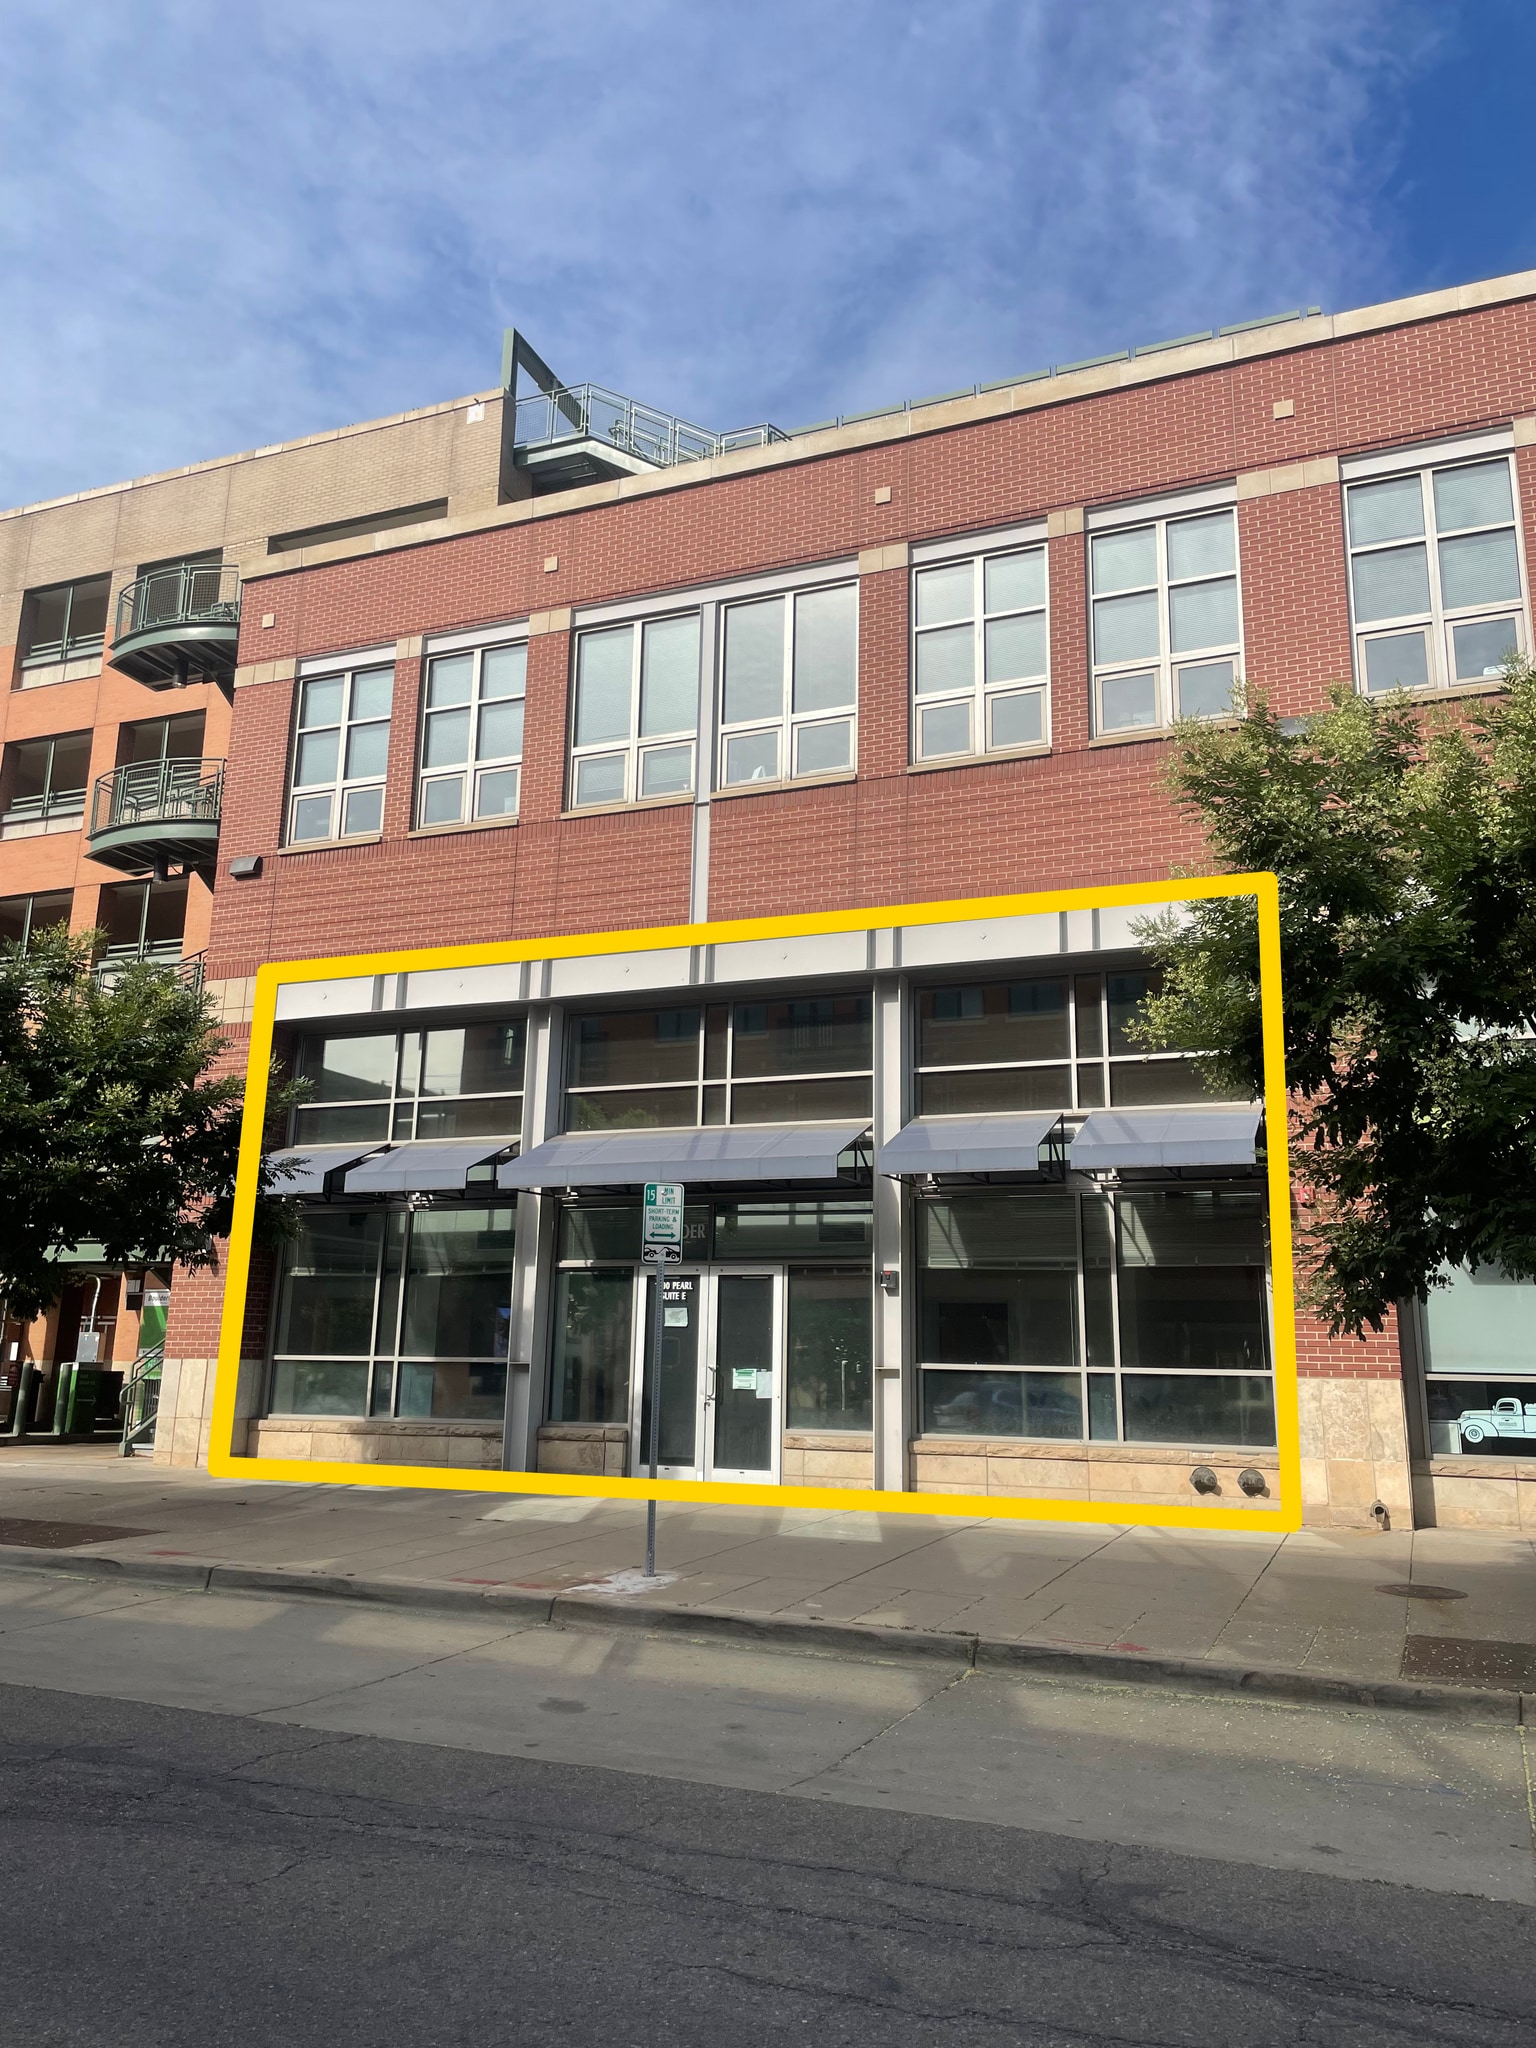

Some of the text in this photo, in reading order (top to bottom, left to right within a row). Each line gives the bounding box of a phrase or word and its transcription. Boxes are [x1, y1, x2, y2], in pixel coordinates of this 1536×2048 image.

[647, 1189, 656, 1201] 15
[664, 1187, 674, 1195] MIN
[648, 1207, 680, 1215] SHORT-TERM
[672, 1281, 693, 1289] PEARL
[682, 1292, 686, 1300] E
